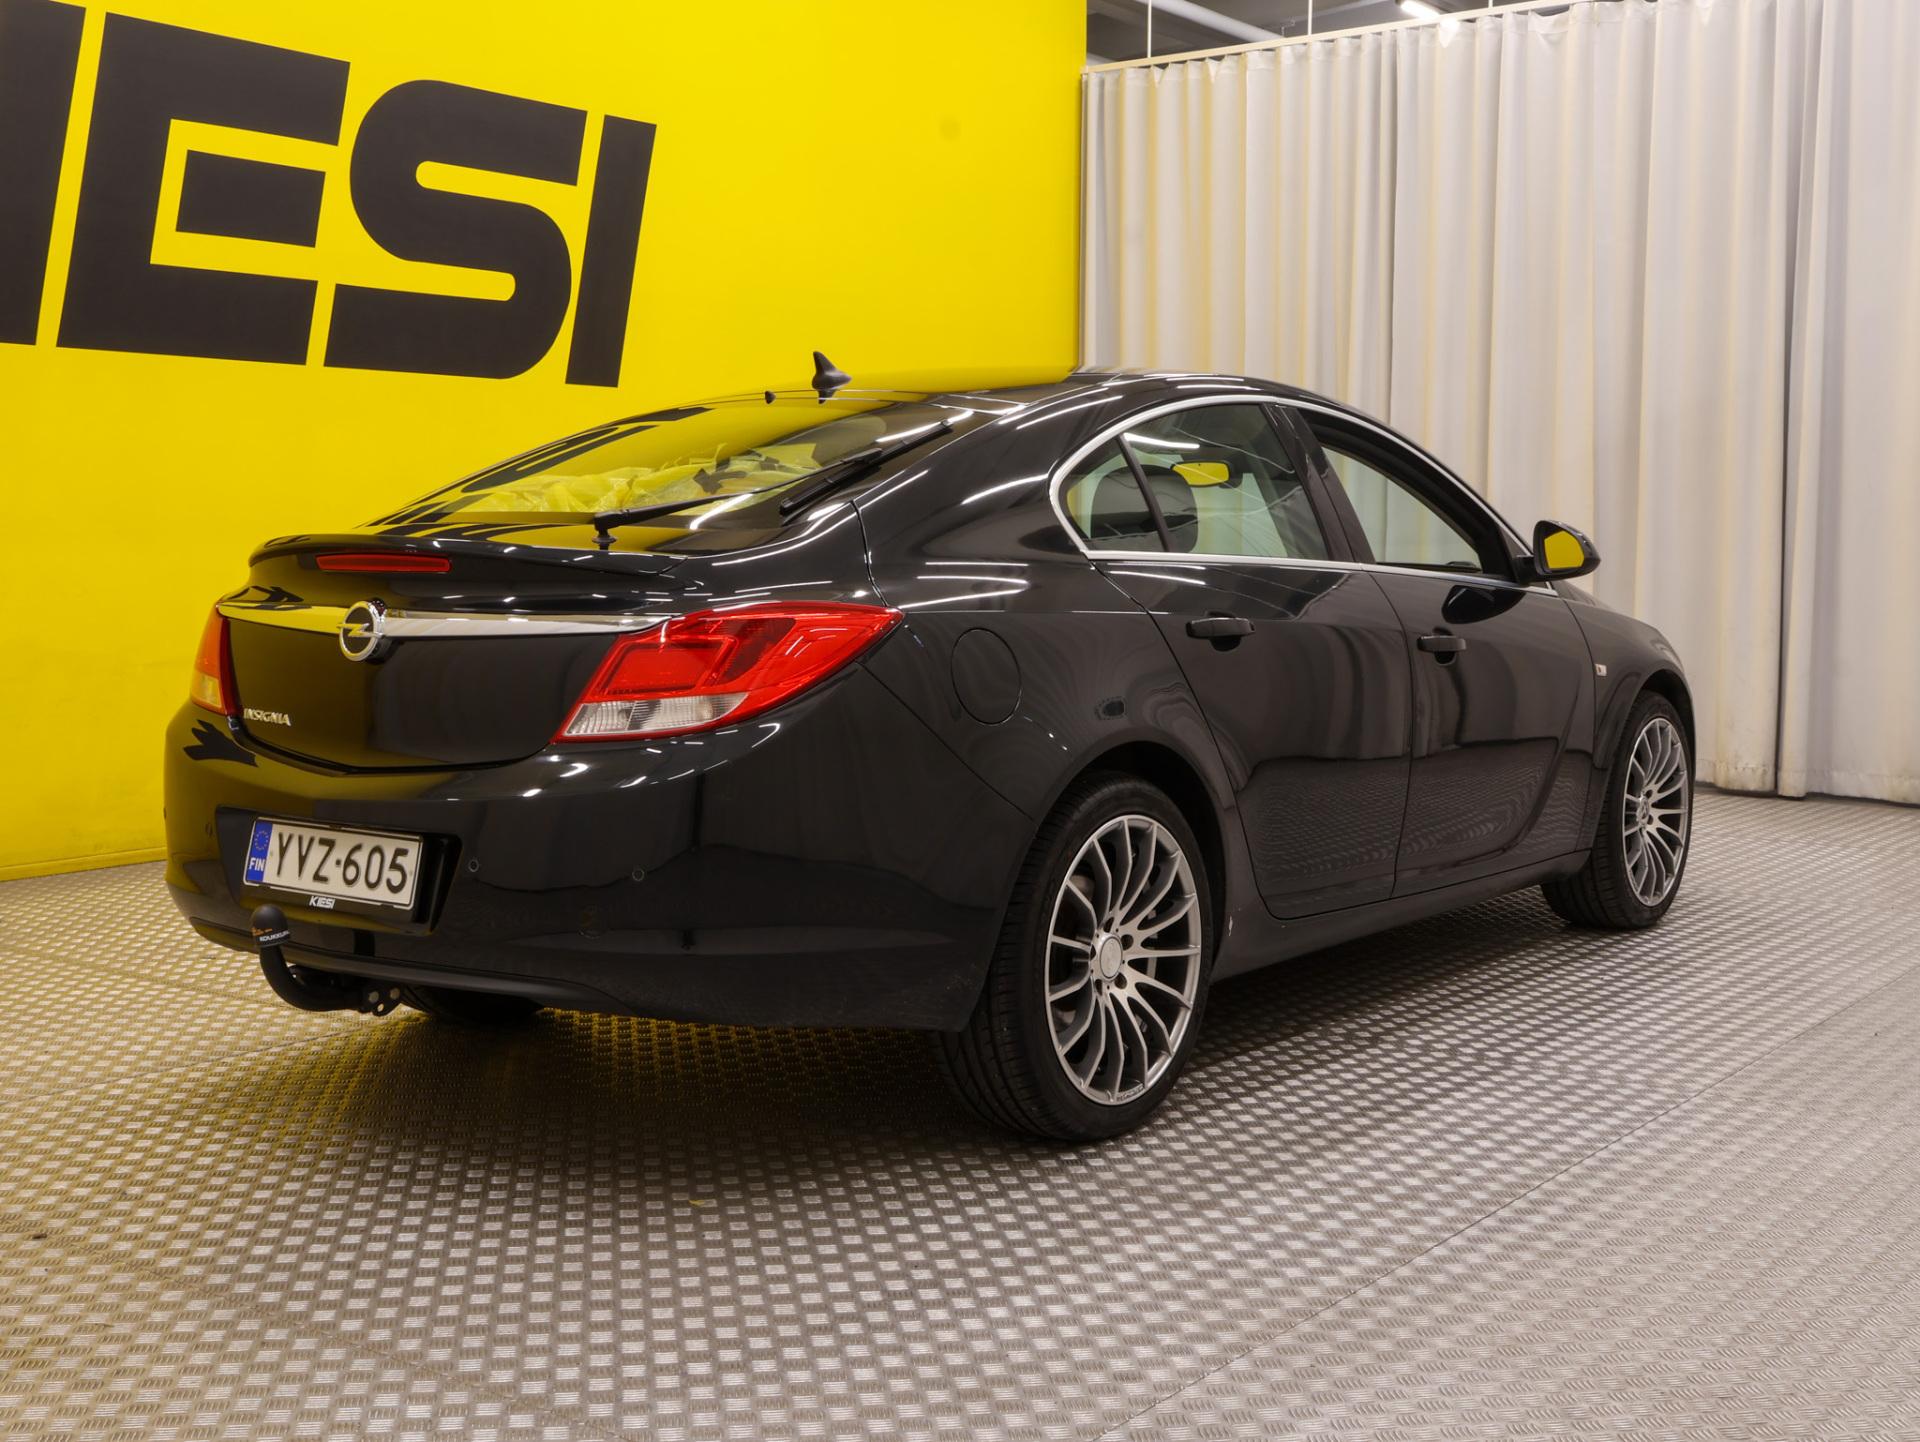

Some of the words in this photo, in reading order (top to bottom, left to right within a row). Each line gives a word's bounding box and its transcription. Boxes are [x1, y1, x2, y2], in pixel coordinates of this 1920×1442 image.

[248, 857, 266, 872] FIN
[276, 832, 410, 894] YVZ-605
[309, 895, 336, 909] KIESI
